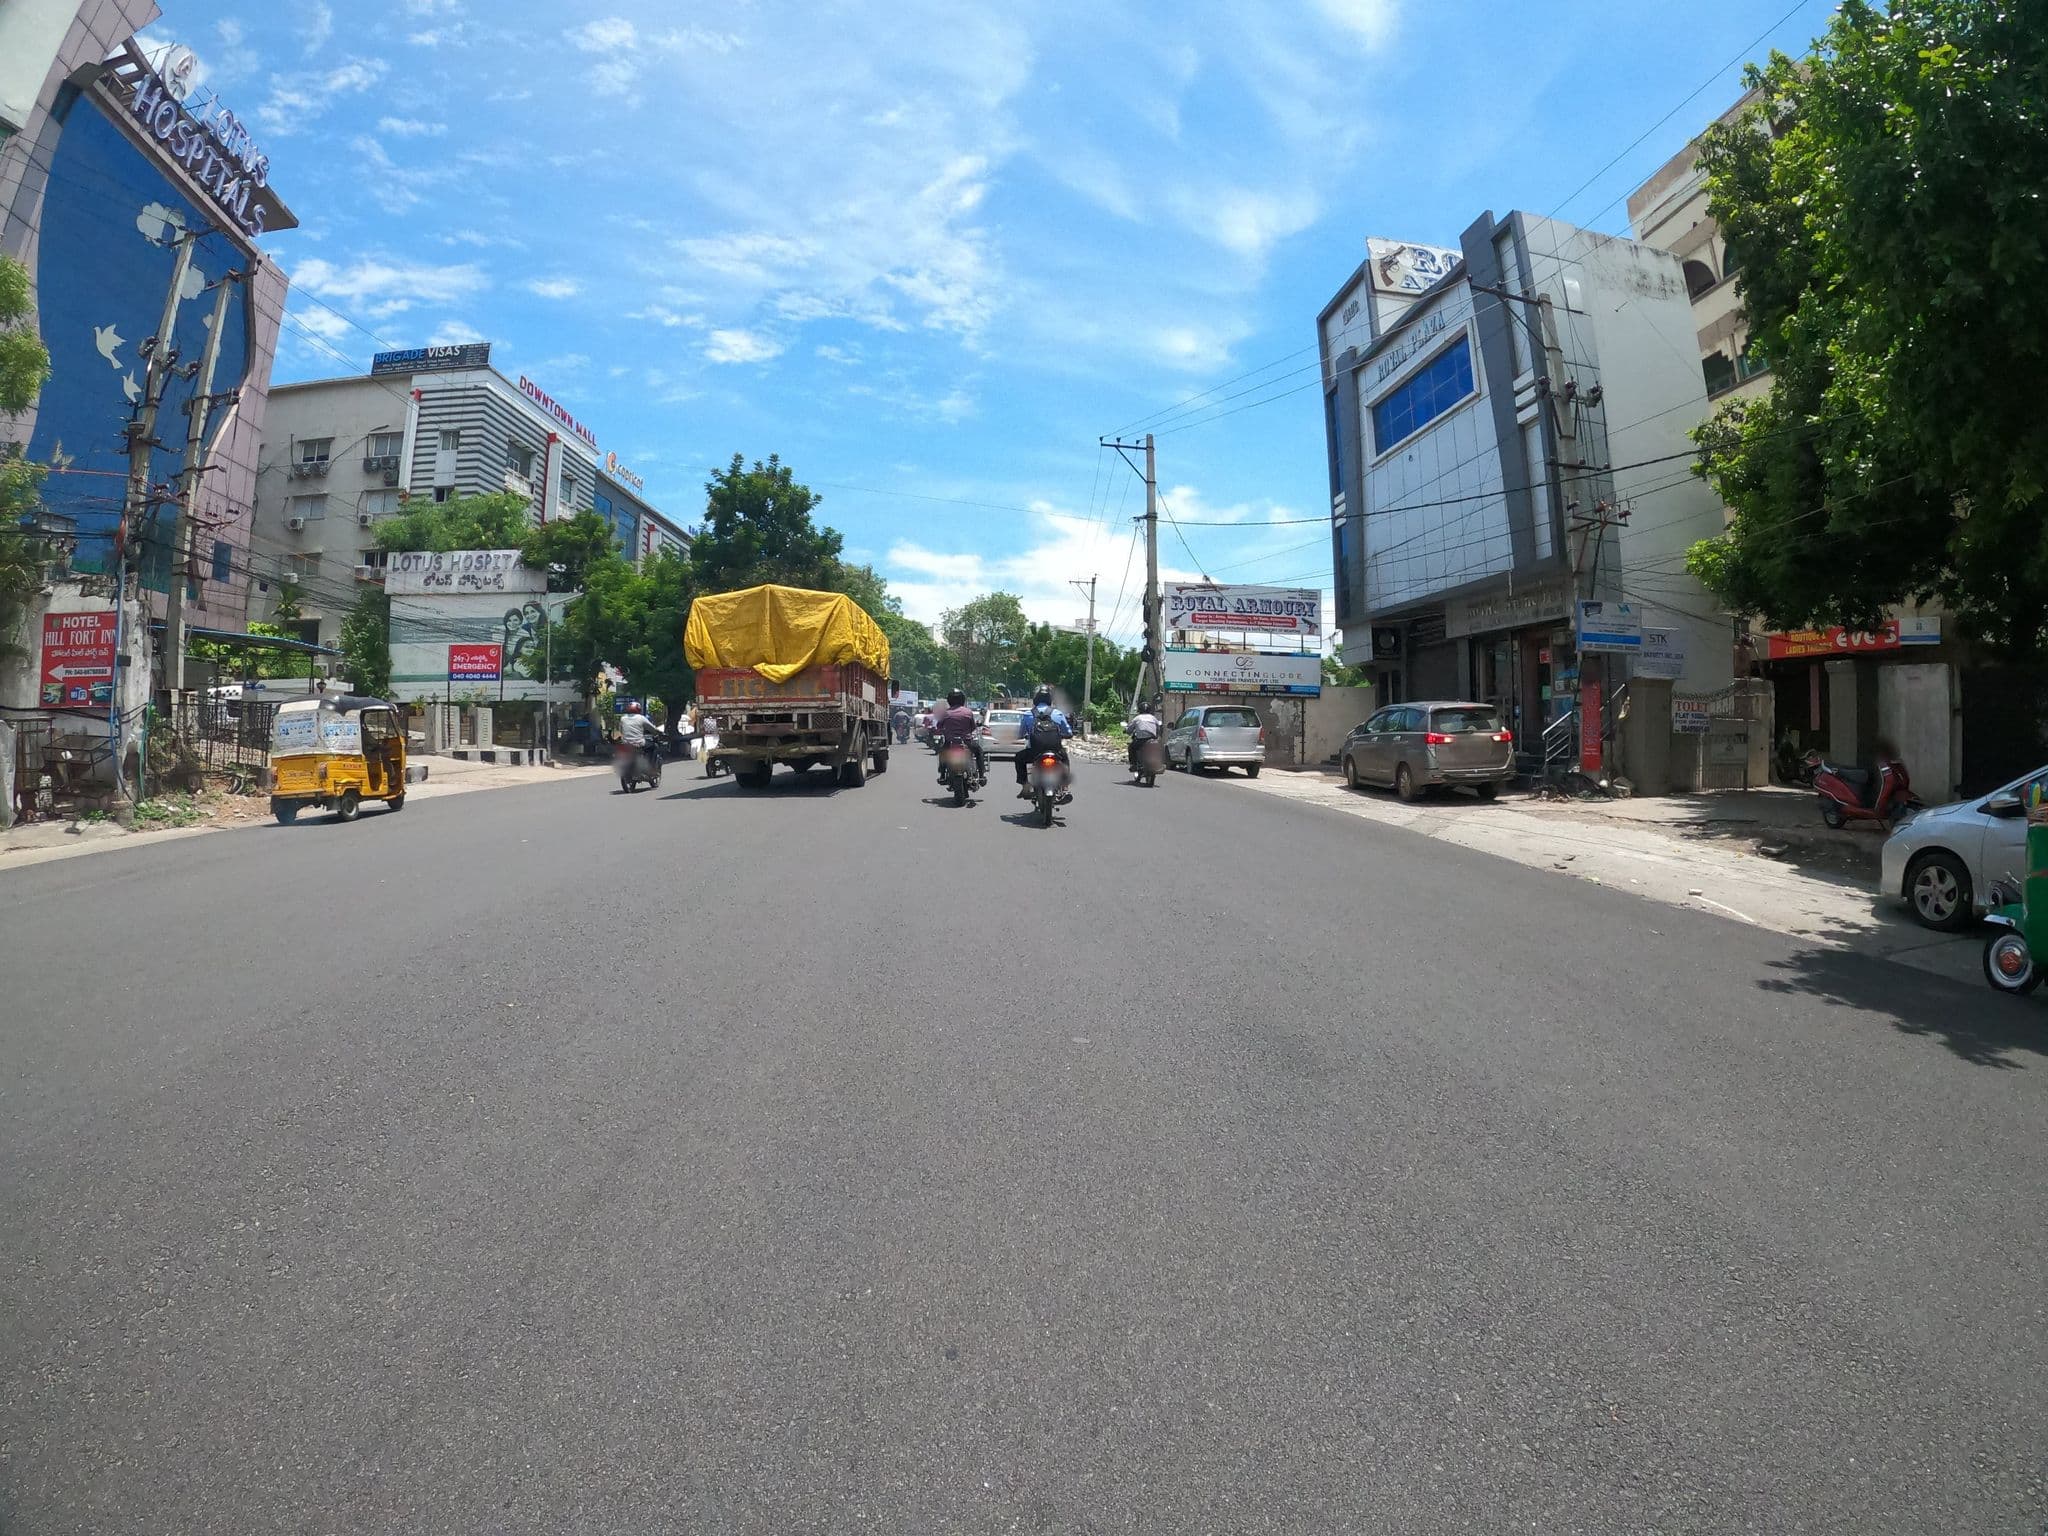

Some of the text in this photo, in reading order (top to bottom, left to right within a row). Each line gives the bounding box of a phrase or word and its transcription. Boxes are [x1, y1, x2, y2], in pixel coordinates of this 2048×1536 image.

[203, 93, 271, 188] LOTUS
[131, 74, 267, 238] HOSPITALS
[375, 349, 426, 363] BRIGADE
[427, 346, 461, 358] VISAS
[519, 375, 597, 447] DOWNTOWN MALL
[391, 553, 443, 572] LOTUS
[1170, 595, 1317, 617] ROYAL ARMOURY
[63, 616, 101, 628] HOTEL
[45, 631, 64, 646] HILL
[70, 630, 96, 645] FORT
[1649, 634, 1668, 644] STK
[1785, 644, 1805, 655] LADIES
